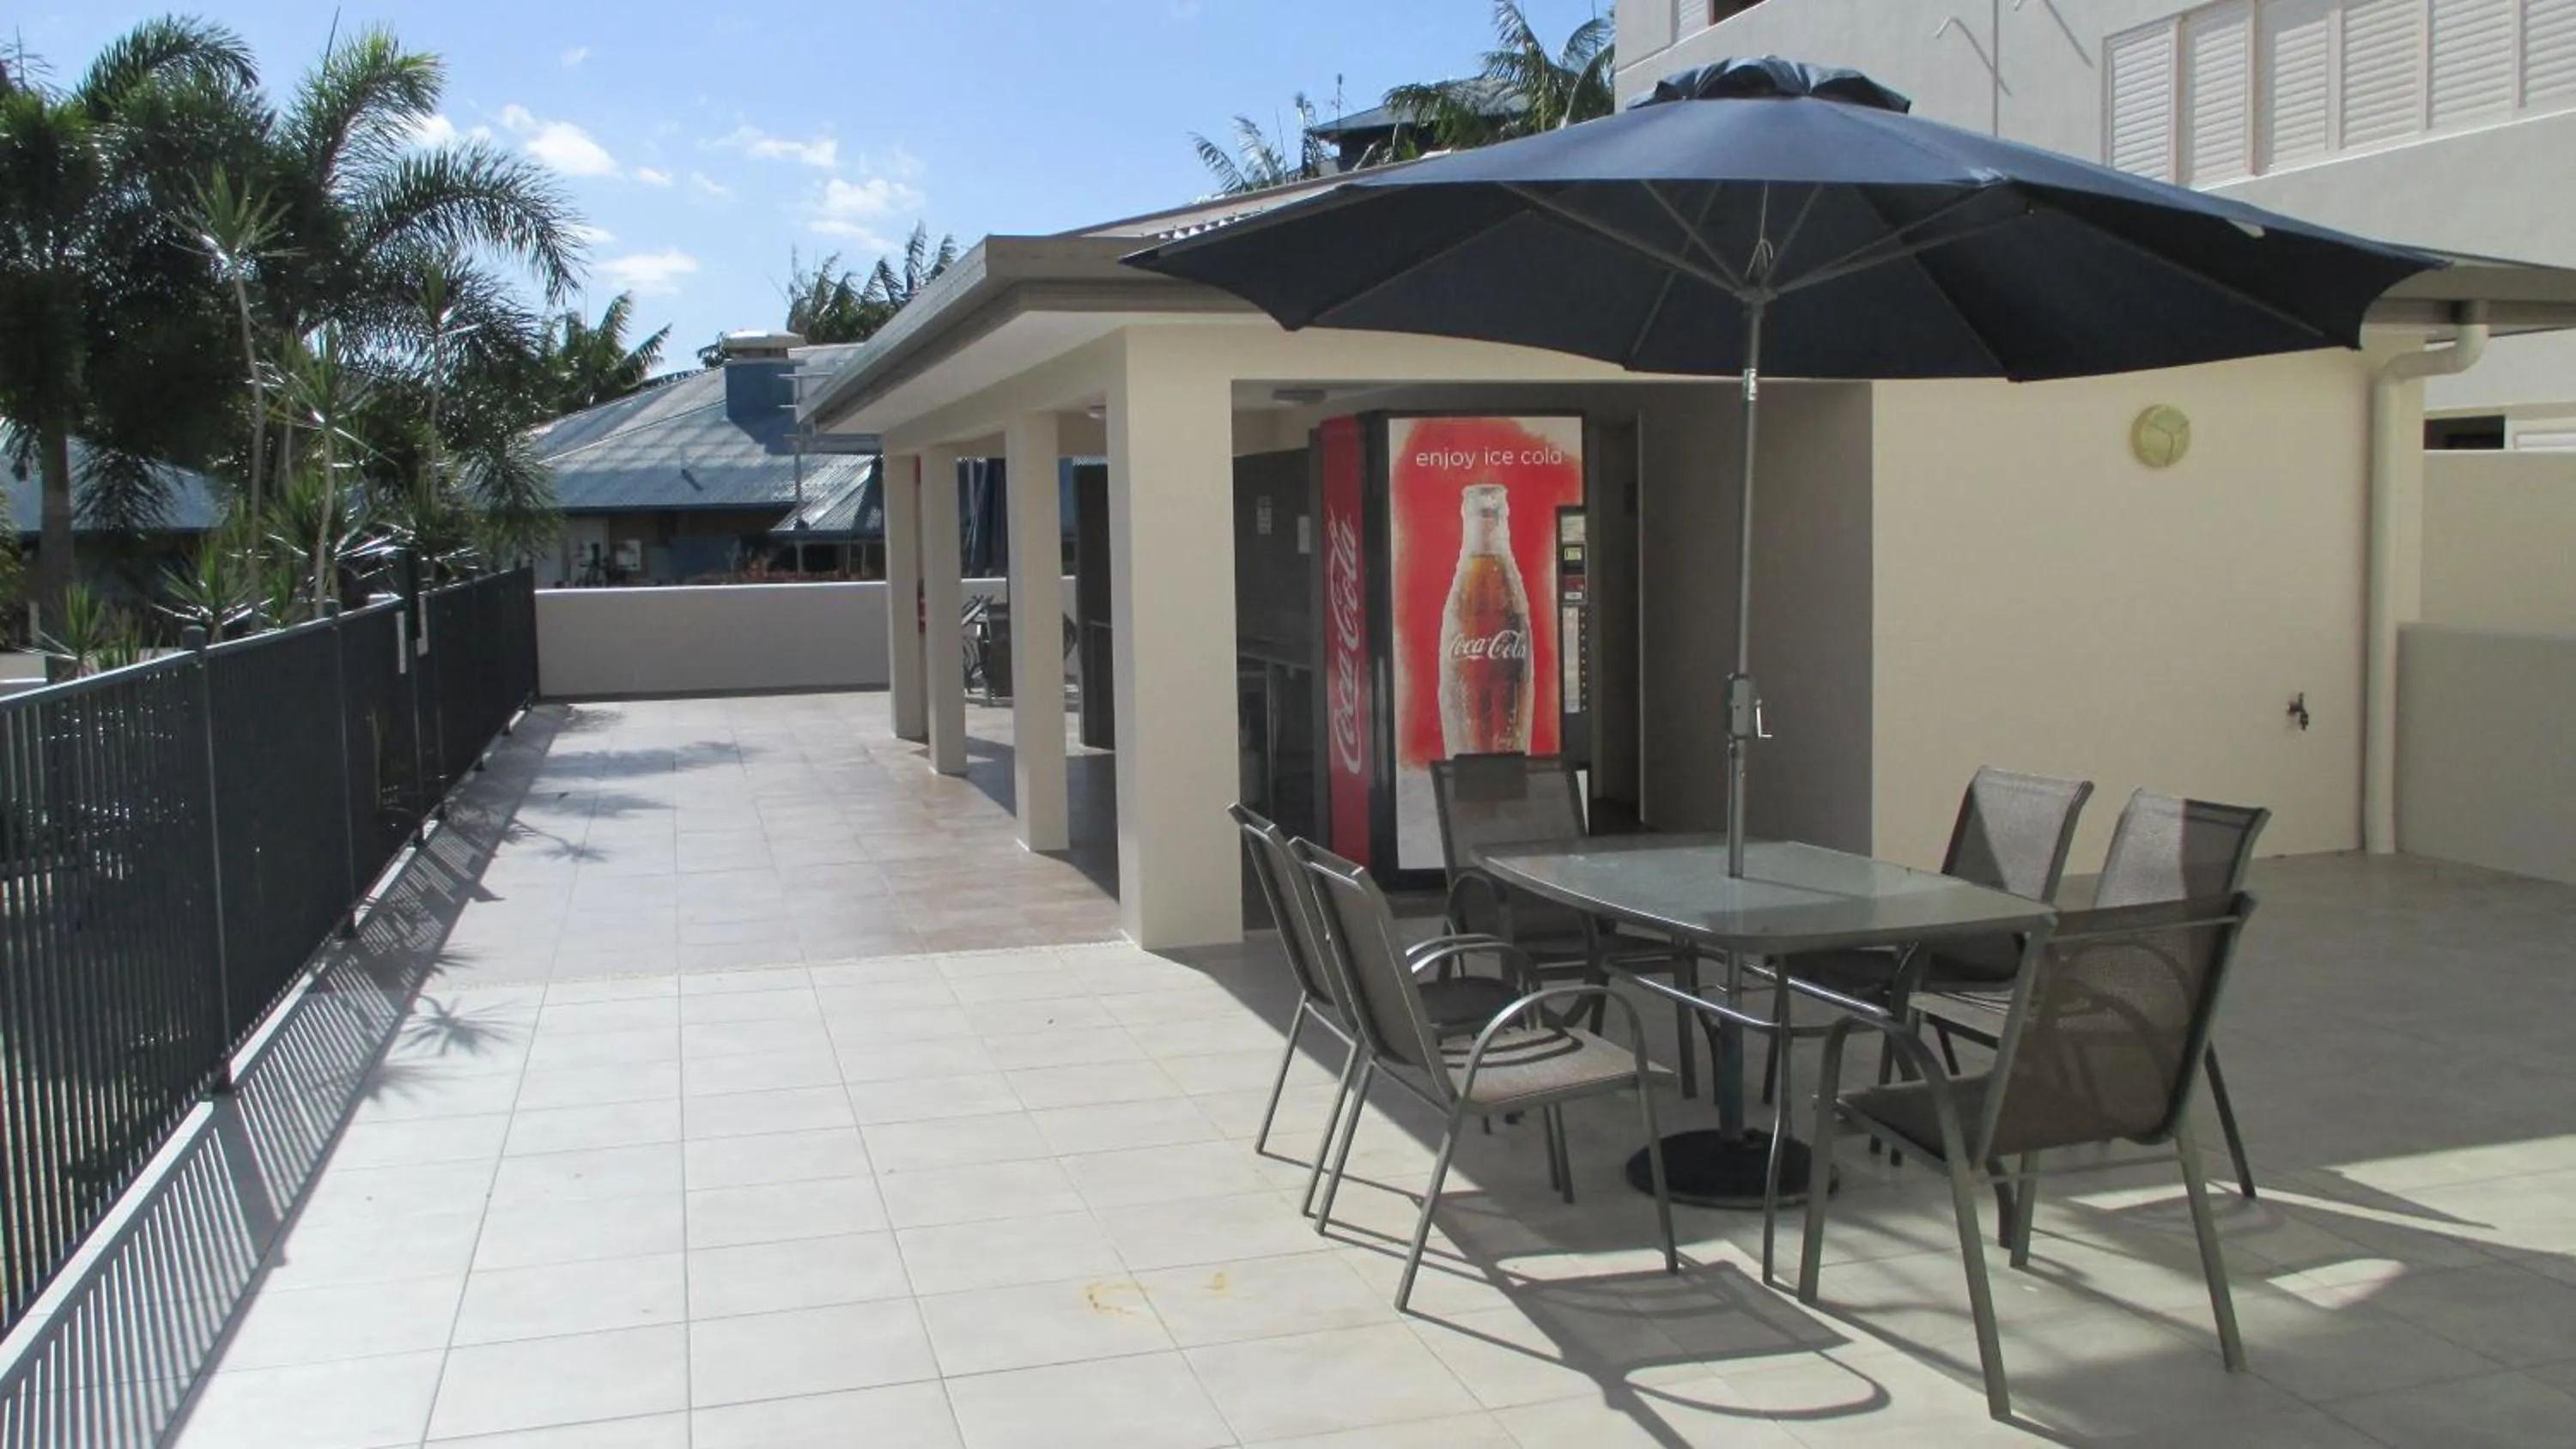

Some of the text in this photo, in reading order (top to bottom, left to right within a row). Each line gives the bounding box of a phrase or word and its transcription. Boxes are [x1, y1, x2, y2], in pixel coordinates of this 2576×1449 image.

[1416, 446, 1563, 470] enjoy ice cold
